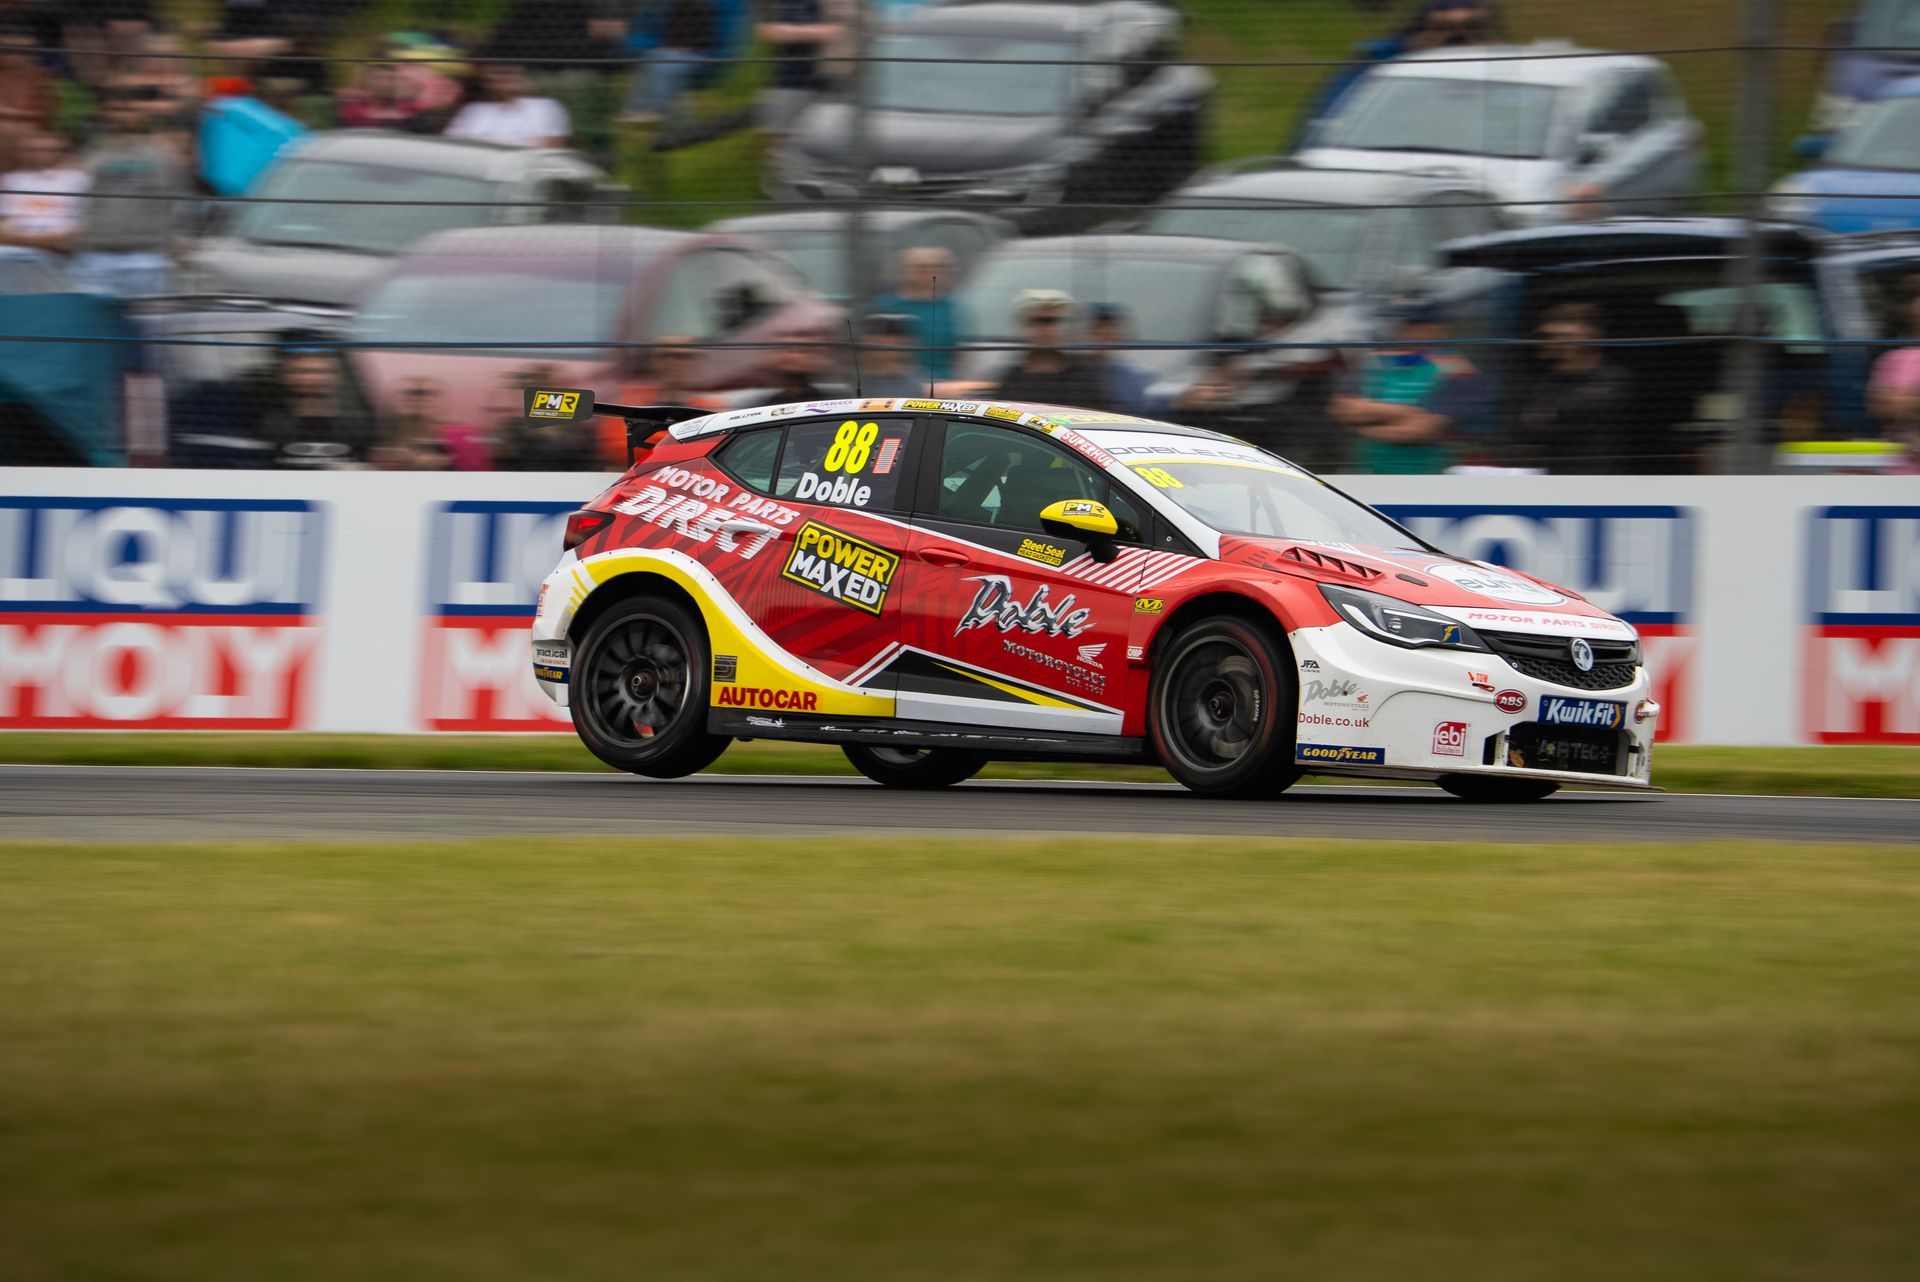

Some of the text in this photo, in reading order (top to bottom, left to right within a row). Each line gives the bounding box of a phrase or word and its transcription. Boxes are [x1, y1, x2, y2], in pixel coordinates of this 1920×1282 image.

[534, 394, 576, 409] PMR
[905, 401, 941, 410] POWER
[939, 402, 975, 412] MAXED
[823, 420, 879, 474] 88
[1061, 431, 1116, 468] SUPERHUB
[795, 472, 871, 506] Doble
[1134, 467, 1184, 489] 88
[651, 466, 801, 525] MOTOR PARTS
[1065, 502, 1104, 514] PMR
[612, 486, 784, 560] DIRECT
[800, 527, 890, 583] POWER
[1021, 538, 1066, 558] Steel Seal
[789, 550, 882, 605] MAXED
[953, 574, 1097, 639] Doble
[1468, 612, 1535, 624] MOTOR
[1543, 618, 1586, 628] PARTS
[1003, 639, 1107, 687] MOTORCYCLES
[1076, 655, 1104, 670] HONDA
[1300, 659, 1320, 669] JFA
[1475, 672, 1489, 683] TOW
[717, 686, 818, 711] AUTOCAR
[1303, 679, 1361, 707] Doble
[1500, 696, 1524, 707] ABS
[1298, 712, 1370, 728] Doble.co.uk
[1433, 721, 1467, 746] febi
